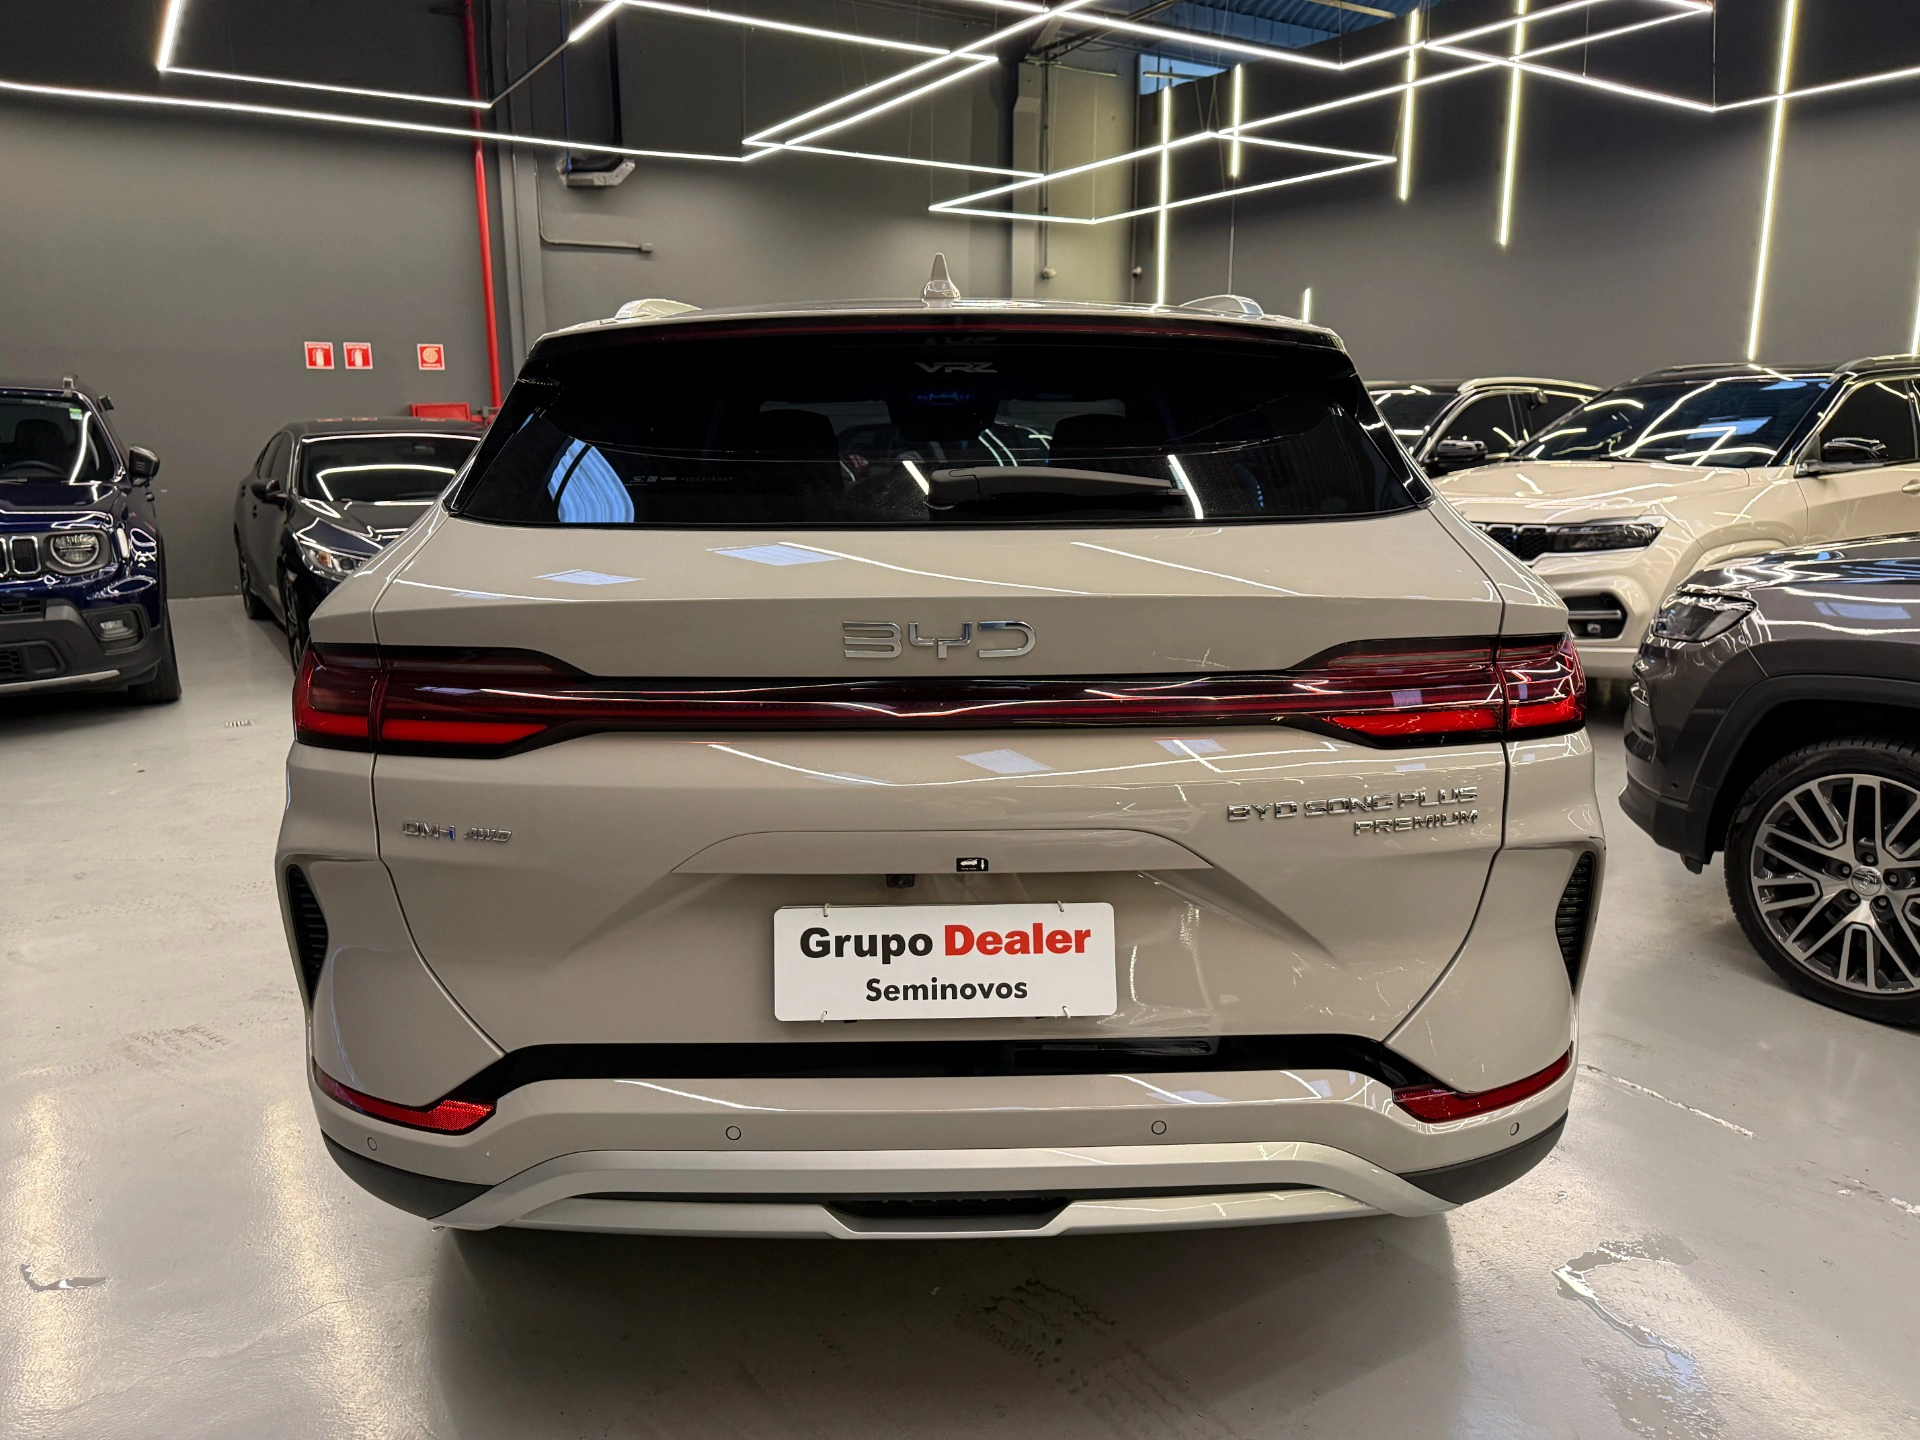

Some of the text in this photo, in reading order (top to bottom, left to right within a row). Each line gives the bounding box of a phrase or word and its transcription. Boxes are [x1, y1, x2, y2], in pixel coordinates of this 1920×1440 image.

[843, 620, 1037, 659] BYD
[1227, 786, 1478, 821] BYD SONG PLUS
[463, 827, 513, 842] AWD
[1354, 809, 1479, 836] PREMIUM
[799, 922, 1092, 965] Grupo Dealer
[865, 976, 1028, 1002] Seminovos
